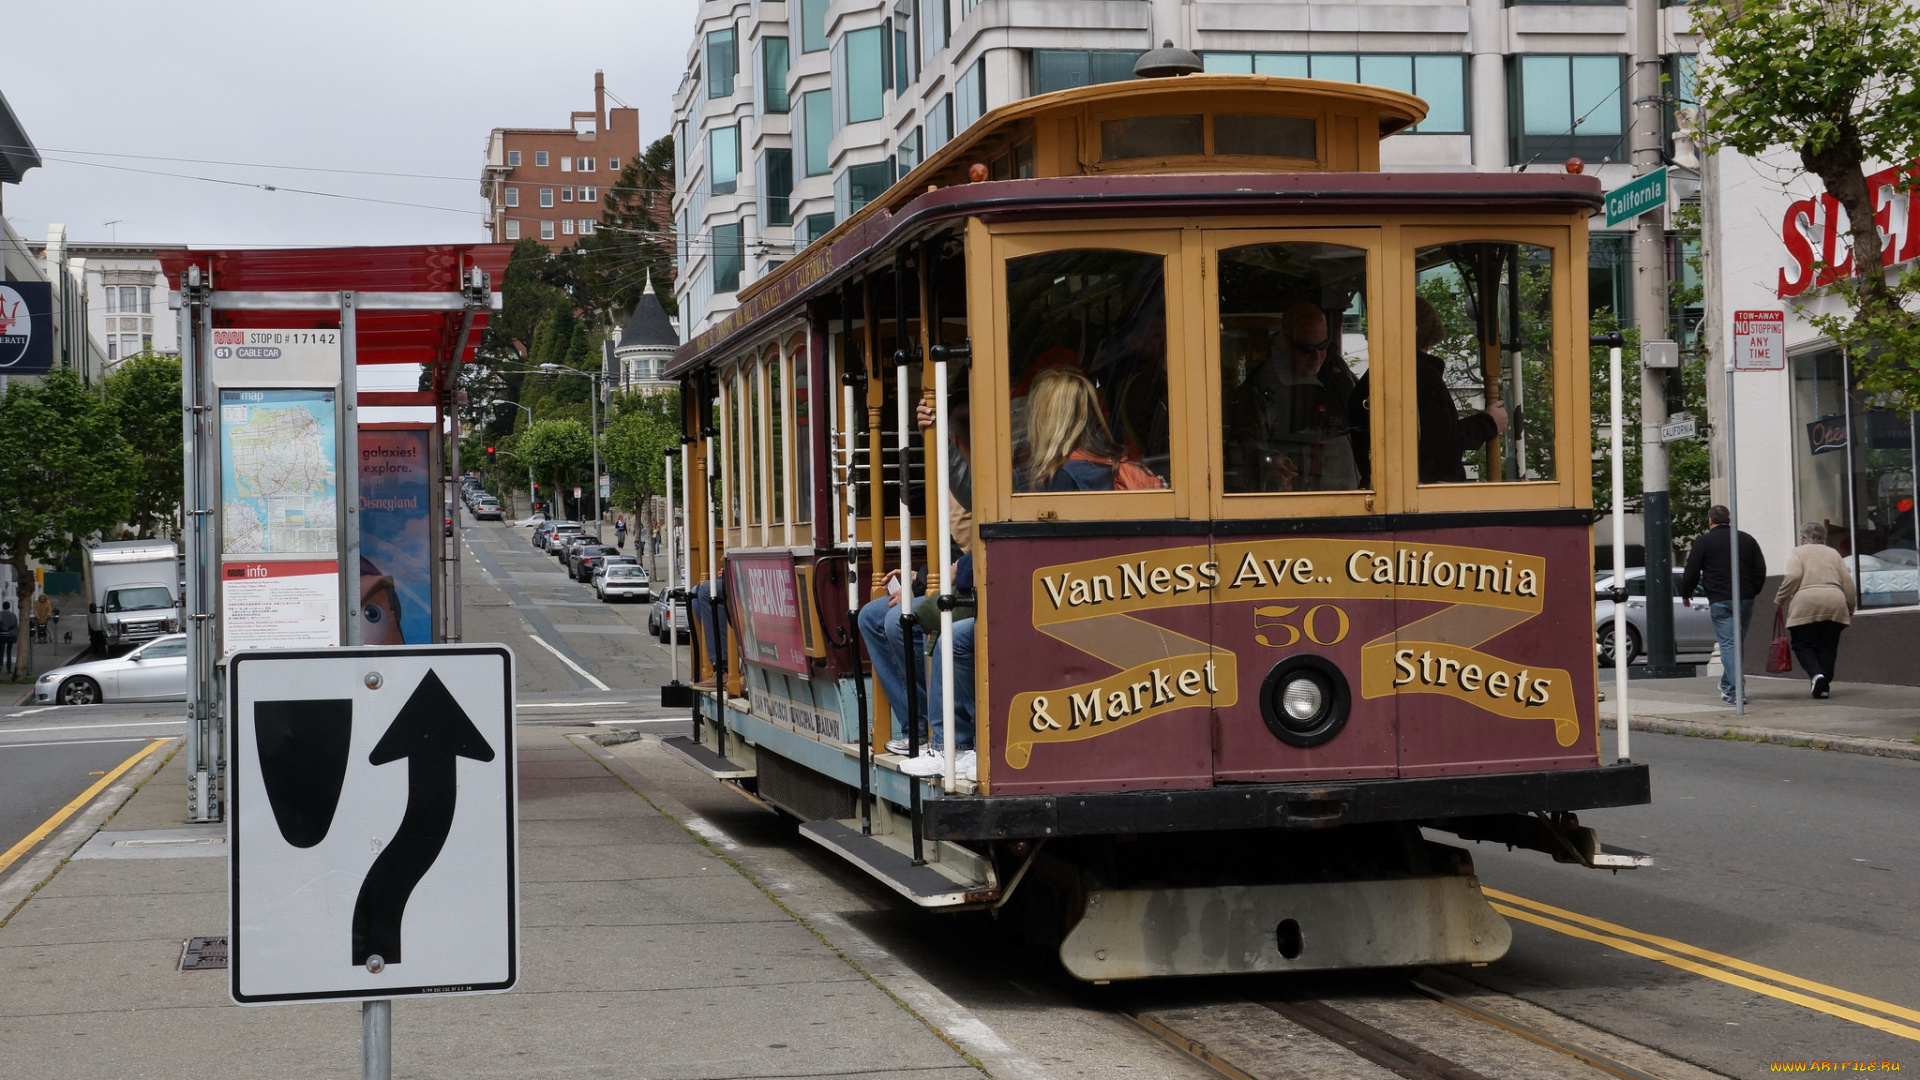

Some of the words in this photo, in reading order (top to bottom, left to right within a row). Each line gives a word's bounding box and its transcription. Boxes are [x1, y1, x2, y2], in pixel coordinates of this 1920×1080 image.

[1610, 181, 1661, 217] California
[1738, 312, 1780, 320] TOW-AWAY
[1736, 320, 1748, 334] NO
[1750, 323, 1782, 334] STOPPING
[250, 333, 272, 343] STOP
[274, 333, 282, 343] ID
[284, 334, 290, 343] #
[293, 333, 335, 344] 17142
[1750, 337, 1769, 346] ANY
[216, 348, 229, 357] 61
[239, 348, 262, 357] CABLE
[263, 348, 279, 357] CAR
[1749, 349, 1770, 359] TIME
[241, 391, 264, 402] map
[1662, 423, 1694, 438] CALIFORNIA
[363, 446, 416, 460] galaxies!
[364, 461, 412, 476] explore.
[247, 565, 267, 577] info
[1347, 548, 1539, 598] California
[748, 568, 775, 615] BREAK
[1254, 604, 1350, 647] 50
[1394, 649, 1552, 706] Streets
[1031, 696, 1062, 731] &
[1069, 659, 1219, 727] Market
[815, 714, 840, 740] RAILWAY
